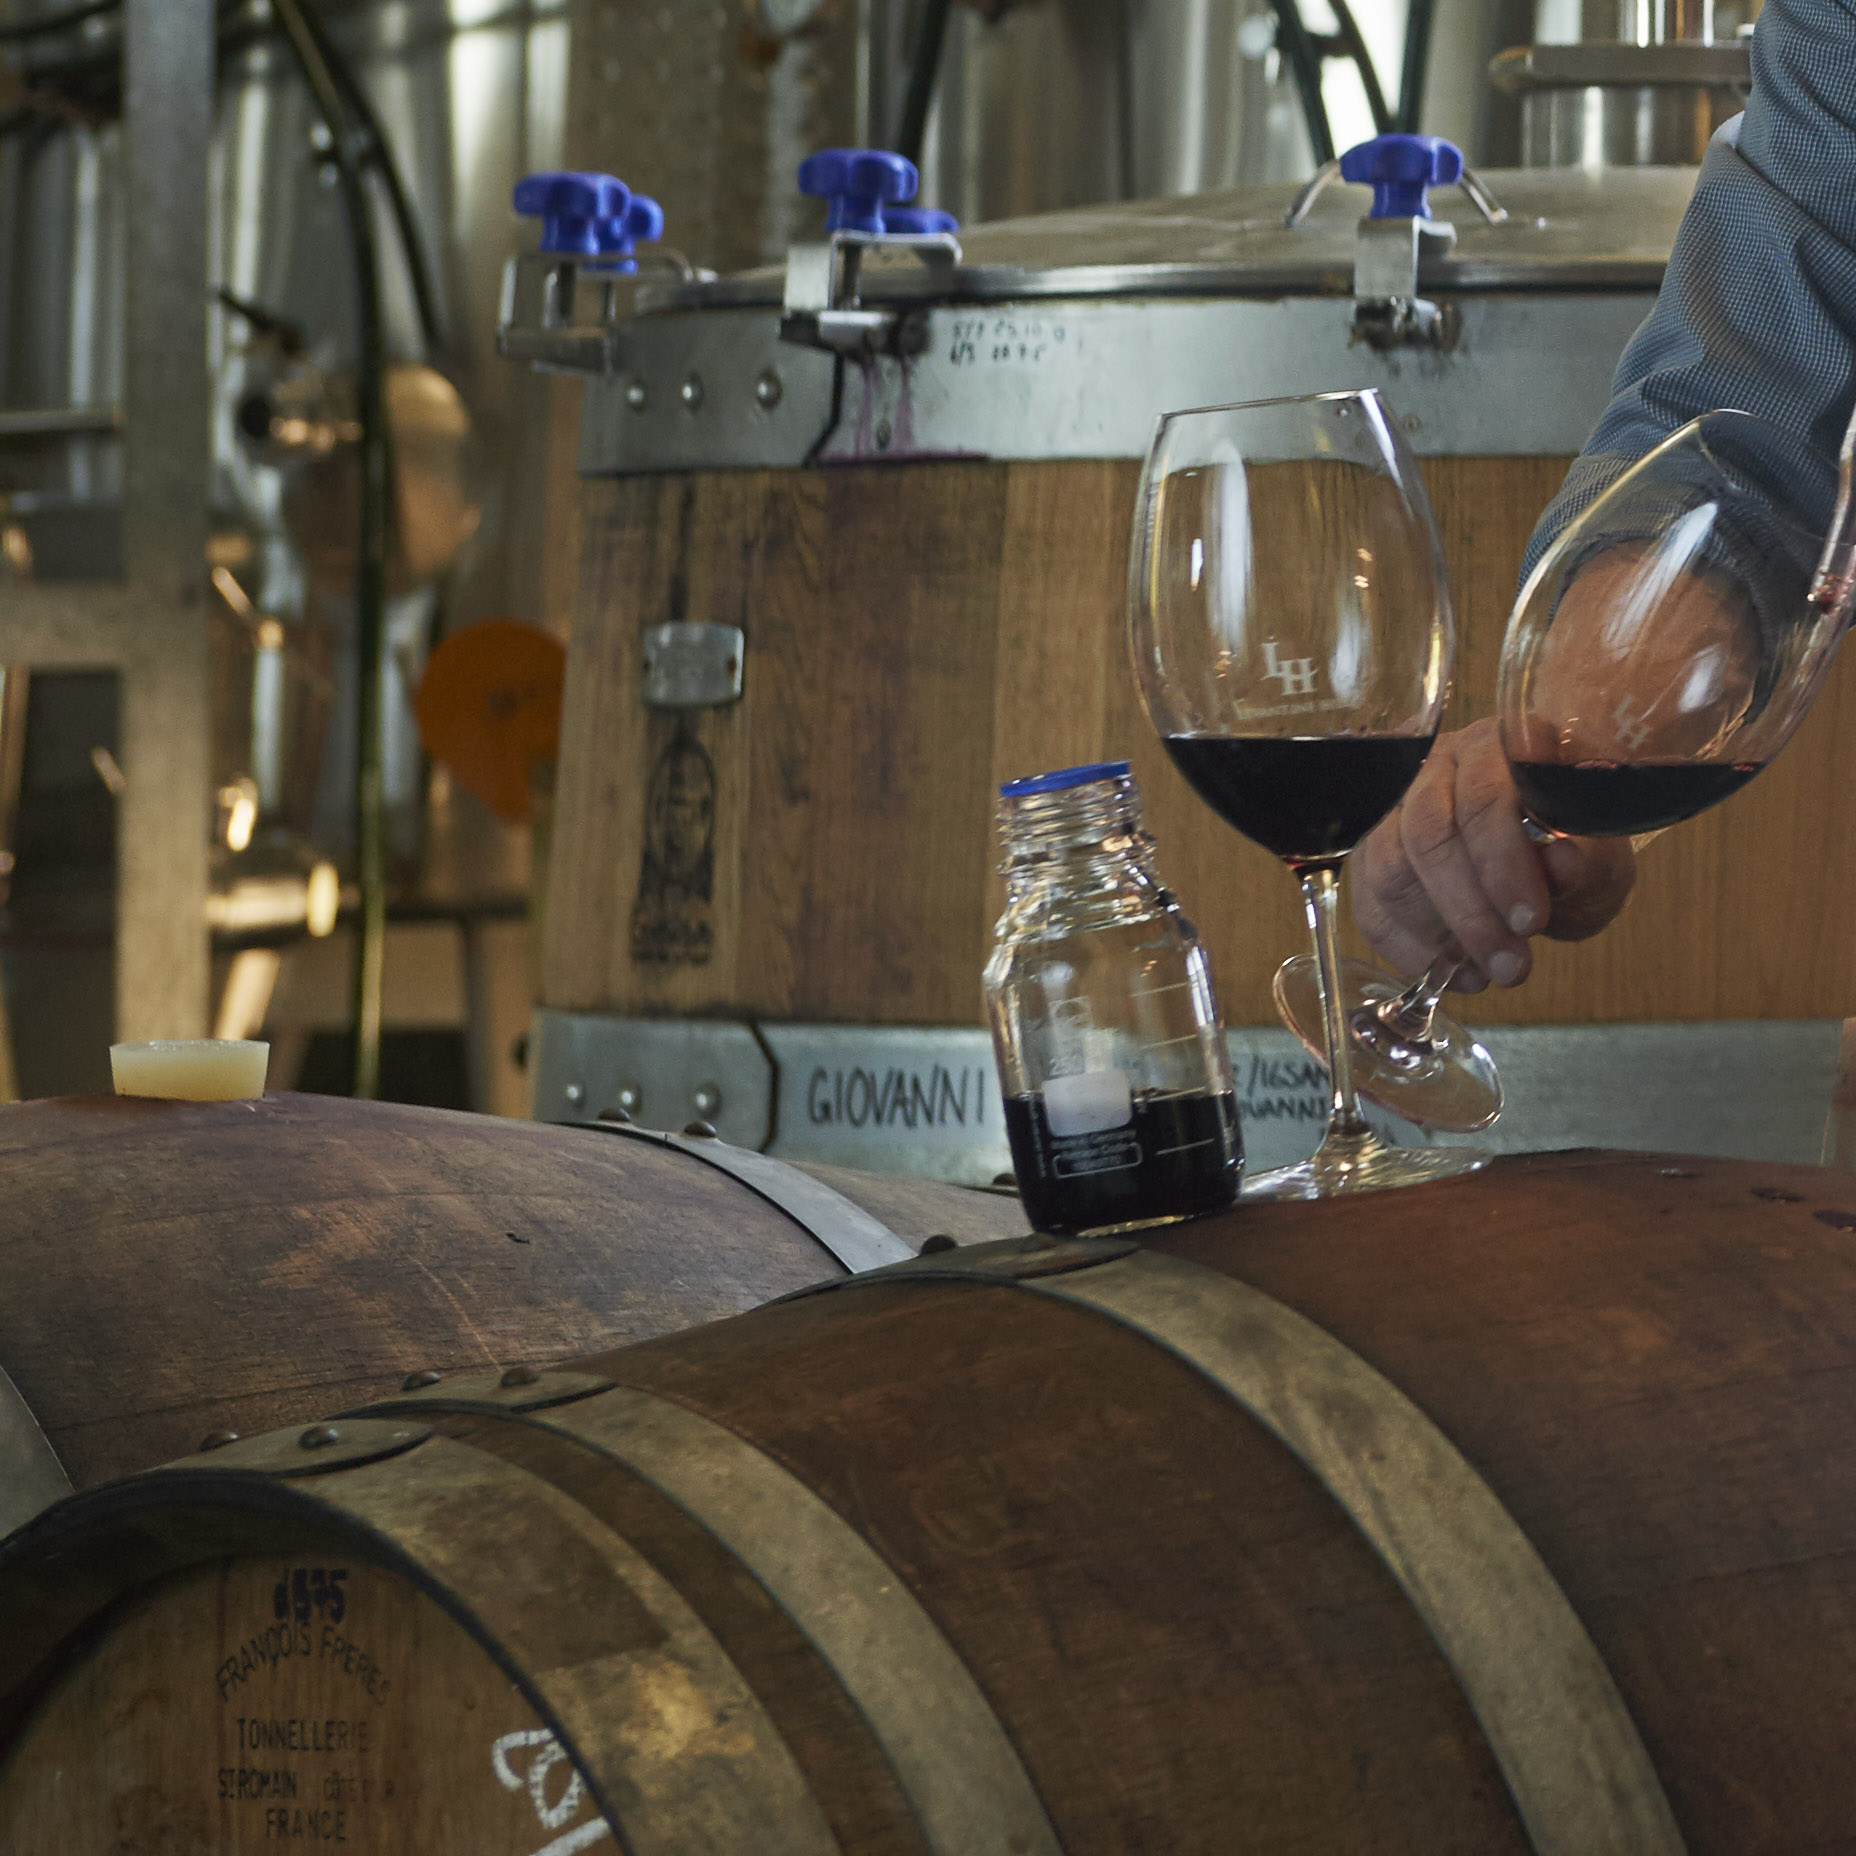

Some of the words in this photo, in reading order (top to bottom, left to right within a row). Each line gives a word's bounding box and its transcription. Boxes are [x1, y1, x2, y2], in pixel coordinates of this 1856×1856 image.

[808, 1064, 984, 1130] GIOVANNI
[237, 1718, 368, 1753] TONNELLERIE
[265, 1808, 347, 1843] FRANCE
